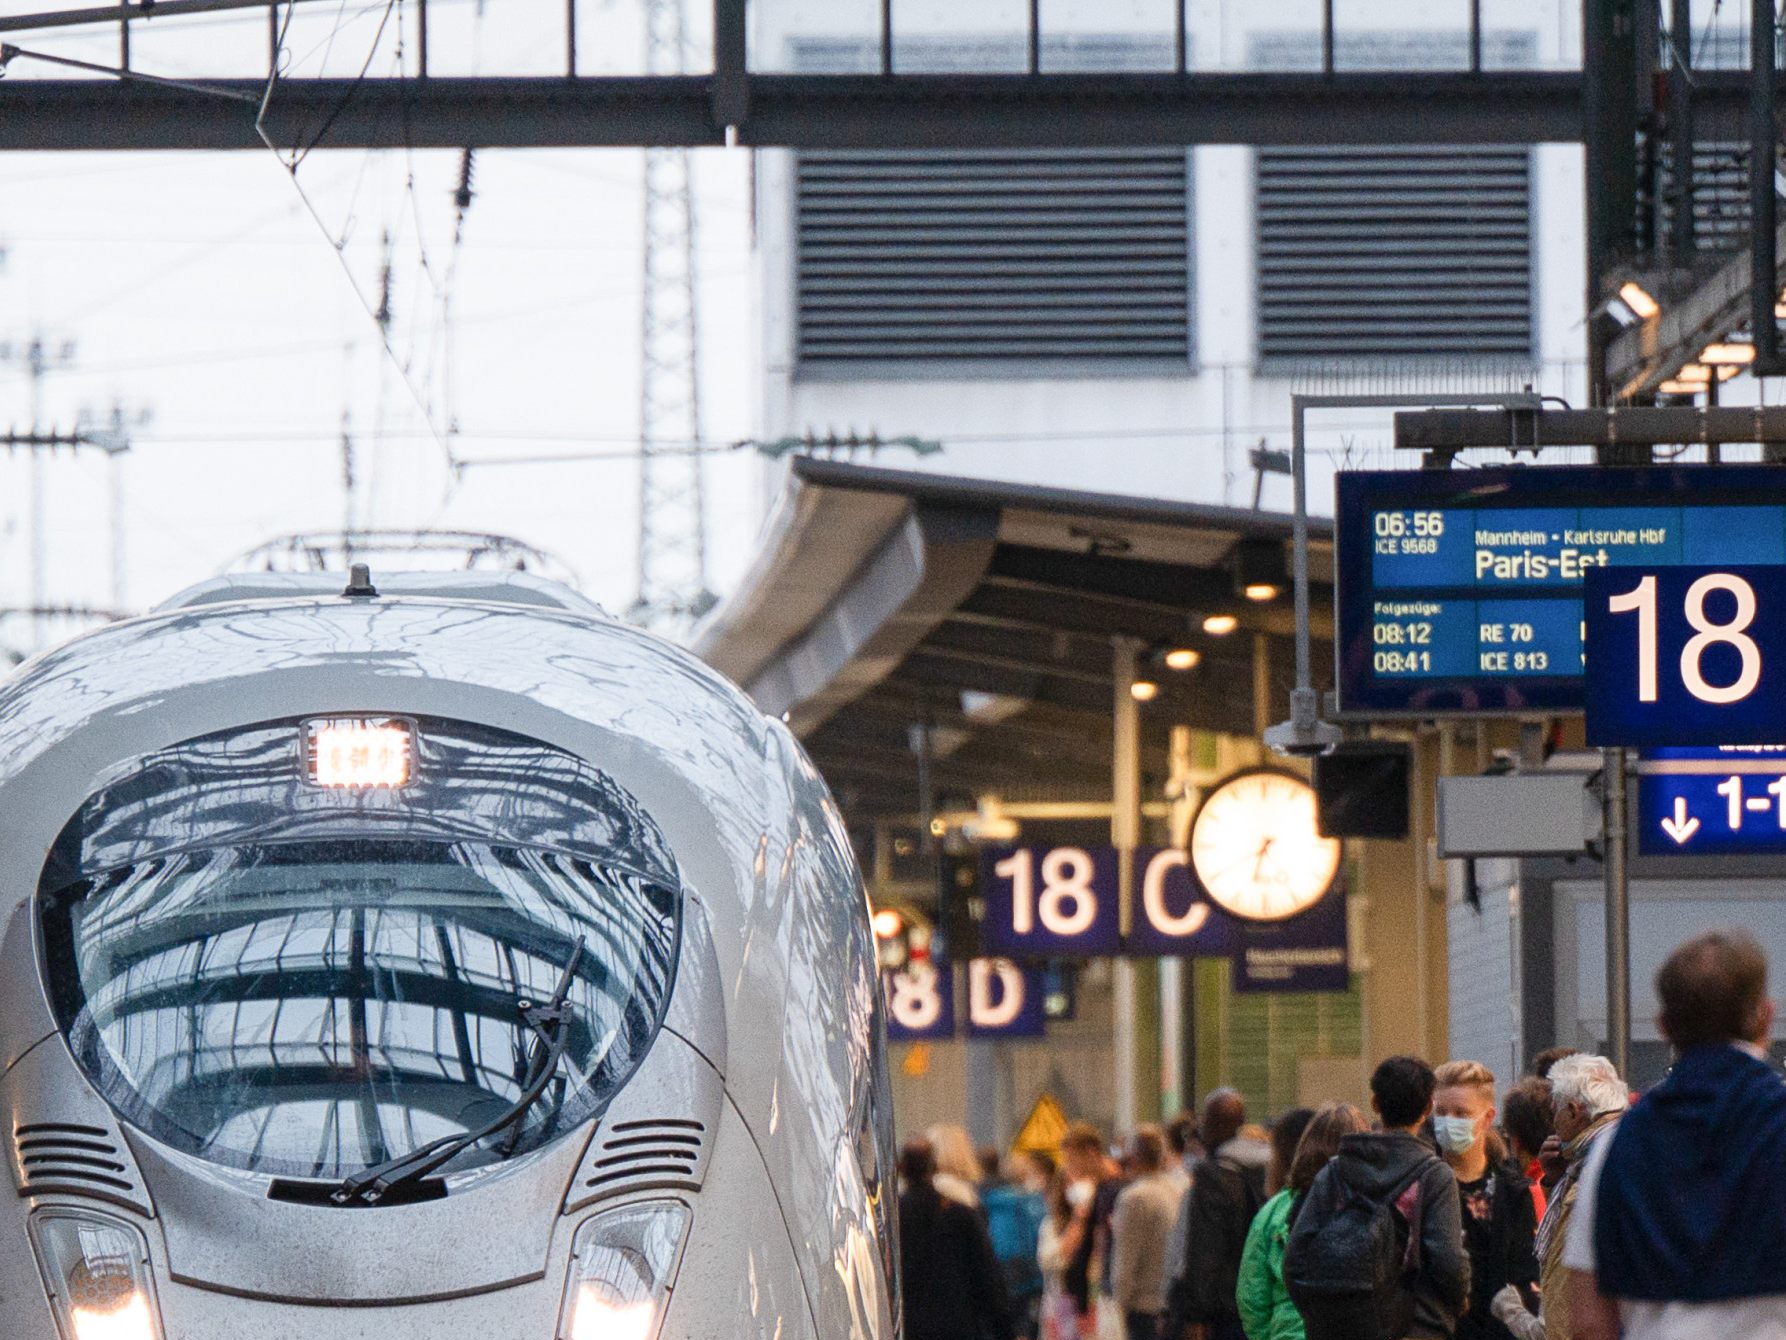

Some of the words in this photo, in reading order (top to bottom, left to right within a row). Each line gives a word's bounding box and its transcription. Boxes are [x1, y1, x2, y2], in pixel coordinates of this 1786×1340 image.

[1374, 512, 1443, 536] 06:56
[1375, 540, 1397, 553] ICE
[1475, 531, 1546, 546] Mannheim
[1564, 529, 1636, 544] Karlsruhe
[1639, 528, 1665, 544] Hbf
[1475, 549, 1608, 579] Paris-Est
[1374, 623, 1431, 643] 08:12
[1480, 624, 1503, 642] RE
[1509, 624, 1533, 642] 70
[1609, 573, 1761, 703] 18
[1374, 651, 1431, 671] 08:41
[1480, 653, 1507, 670] ICE
[1513, 652, 1547, 670] 813
[994, 846, 1097, 936] 18
[1143, 849, 1212, 938] C
[969, 957, 1025, 1028] D
